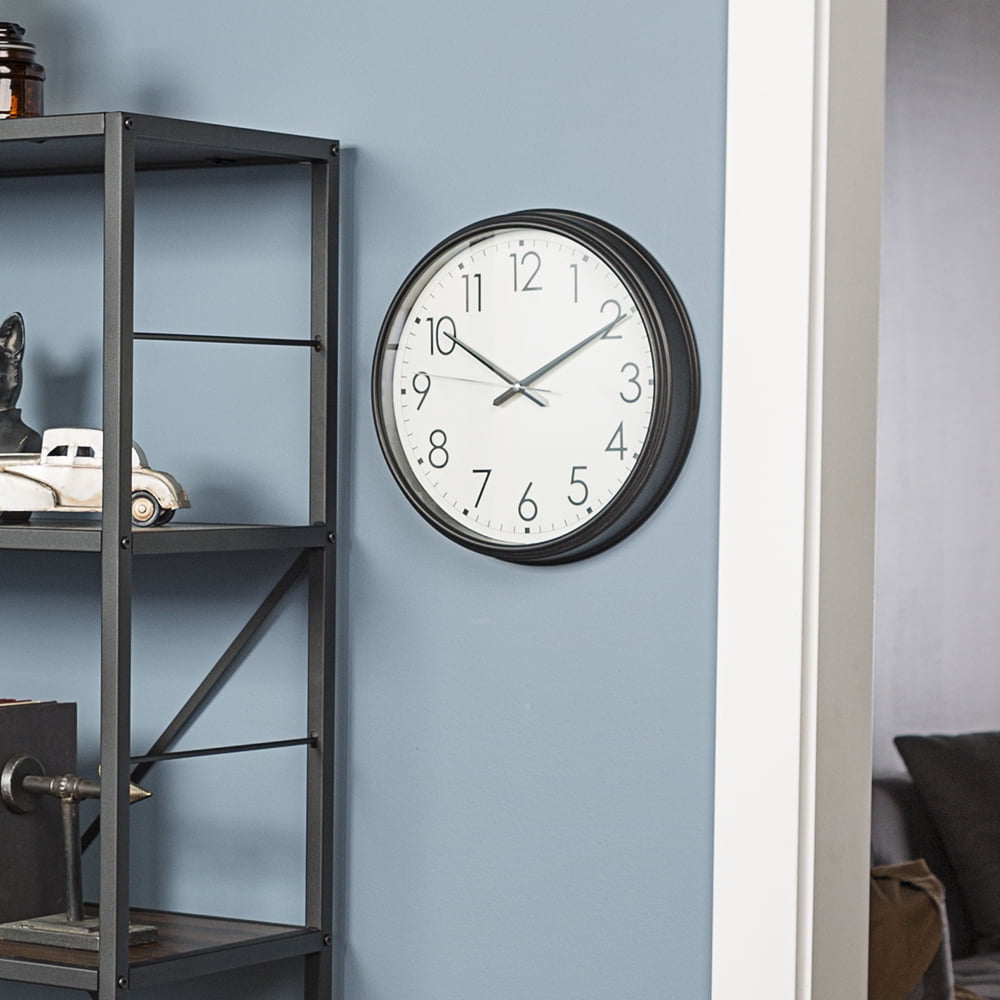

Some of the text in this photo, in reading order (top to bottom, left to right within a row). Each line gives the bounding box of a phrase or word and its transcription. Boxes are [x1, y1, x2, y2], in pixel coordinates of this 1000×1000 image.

[508, 251, 543, 293] 12
[569, 263, 578, 303] 1
[461, 273, 482, 313] 11
[426, 316, 457, 356] 10
[600, 299, 623, 341] 2
[412, 371, 431, 411] 9
[619, 362, 642, 403] 3
[428, 429, 449, 469] 8
[604, 420, 628, 461] 4
[472, 469, 492, 508] 7
[518, 482, 538, 522] 6
[567, 465, 589, 506] 5
